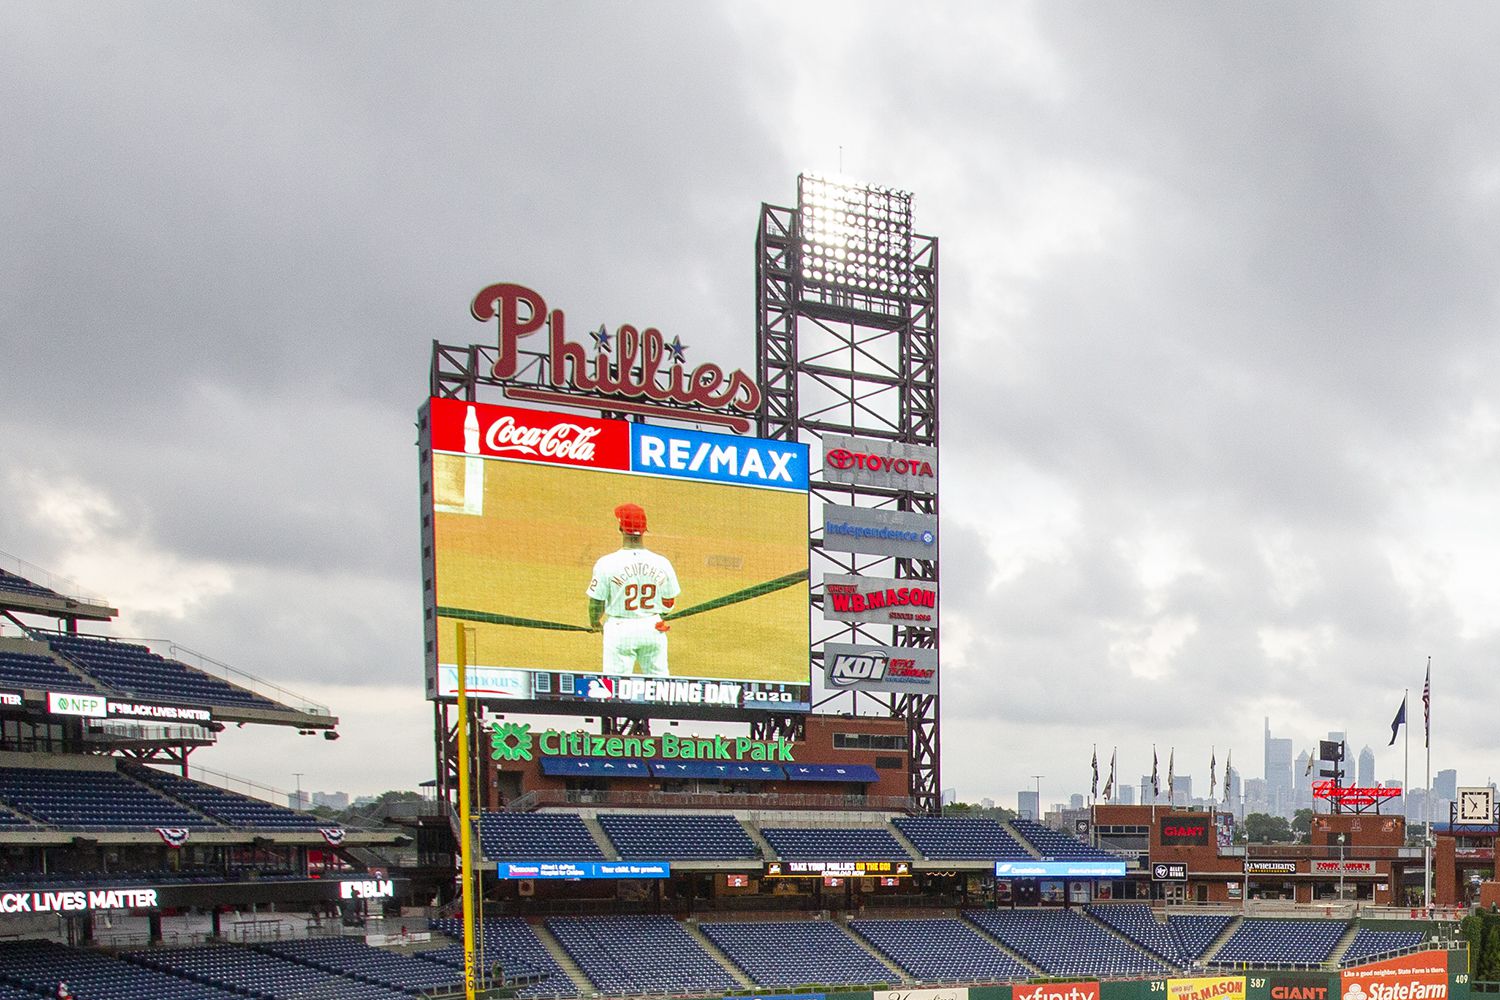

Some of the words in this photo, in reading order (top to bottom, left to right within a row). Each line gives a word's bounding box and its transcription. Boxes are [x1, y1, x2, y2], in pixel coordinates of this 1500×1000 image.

[471, 283, 761, 412] Phillies
[485, 415, 601, 461] Coca-Cola
[640, 435, 794, 483] RE/MAX
[854, 453, 933, 478] TOYOTA
[826, 520, 918, 540] Independence
[624, 583, 657, 611] 22
[889, 612, 913, 620] SINCE
[832, 655, 887, 680] KDI
[618, 679, 700, 701] OPENING
[700, 685, 742, 706] DAY
[743, 690, 793, 703] 2020
[71, 699, 98, 712] NFP
[121, 703, 152, 716] BLACK
[152, 707, 177, 717] LIVES
[177, 708, 210, 721] MATTER
[539, 730, 656, 758] Citizens
[662, 732, 732, 760] Bank
[735, 735, 795, 762] Park
[577, 762, 687, 771] HARRY
[1164, 826, 1205, 837] GIANT
[789, 863, 807, 871] TAKE
[808, 863, 826, 871] YOUR
[826, 863, 855, 871] PHILLIES
[866, 863, 879, 871] THE
[365, 880, 393, 897] BLM
[33, 890, 87, 911] LIVES
[89, 888, 157, 909] MATTER
[466, 951, 474, 991] 329
[1360, 970, 1373, 978] good
[1373, 968, 1397, 977] neighbor,
[1455, 974, 1468, 984] 409
[1150, 981, 1165, 992] 374
[1250, 978, 1265, 988] 387
[1271, 987, 1327, 1000] GIANT
